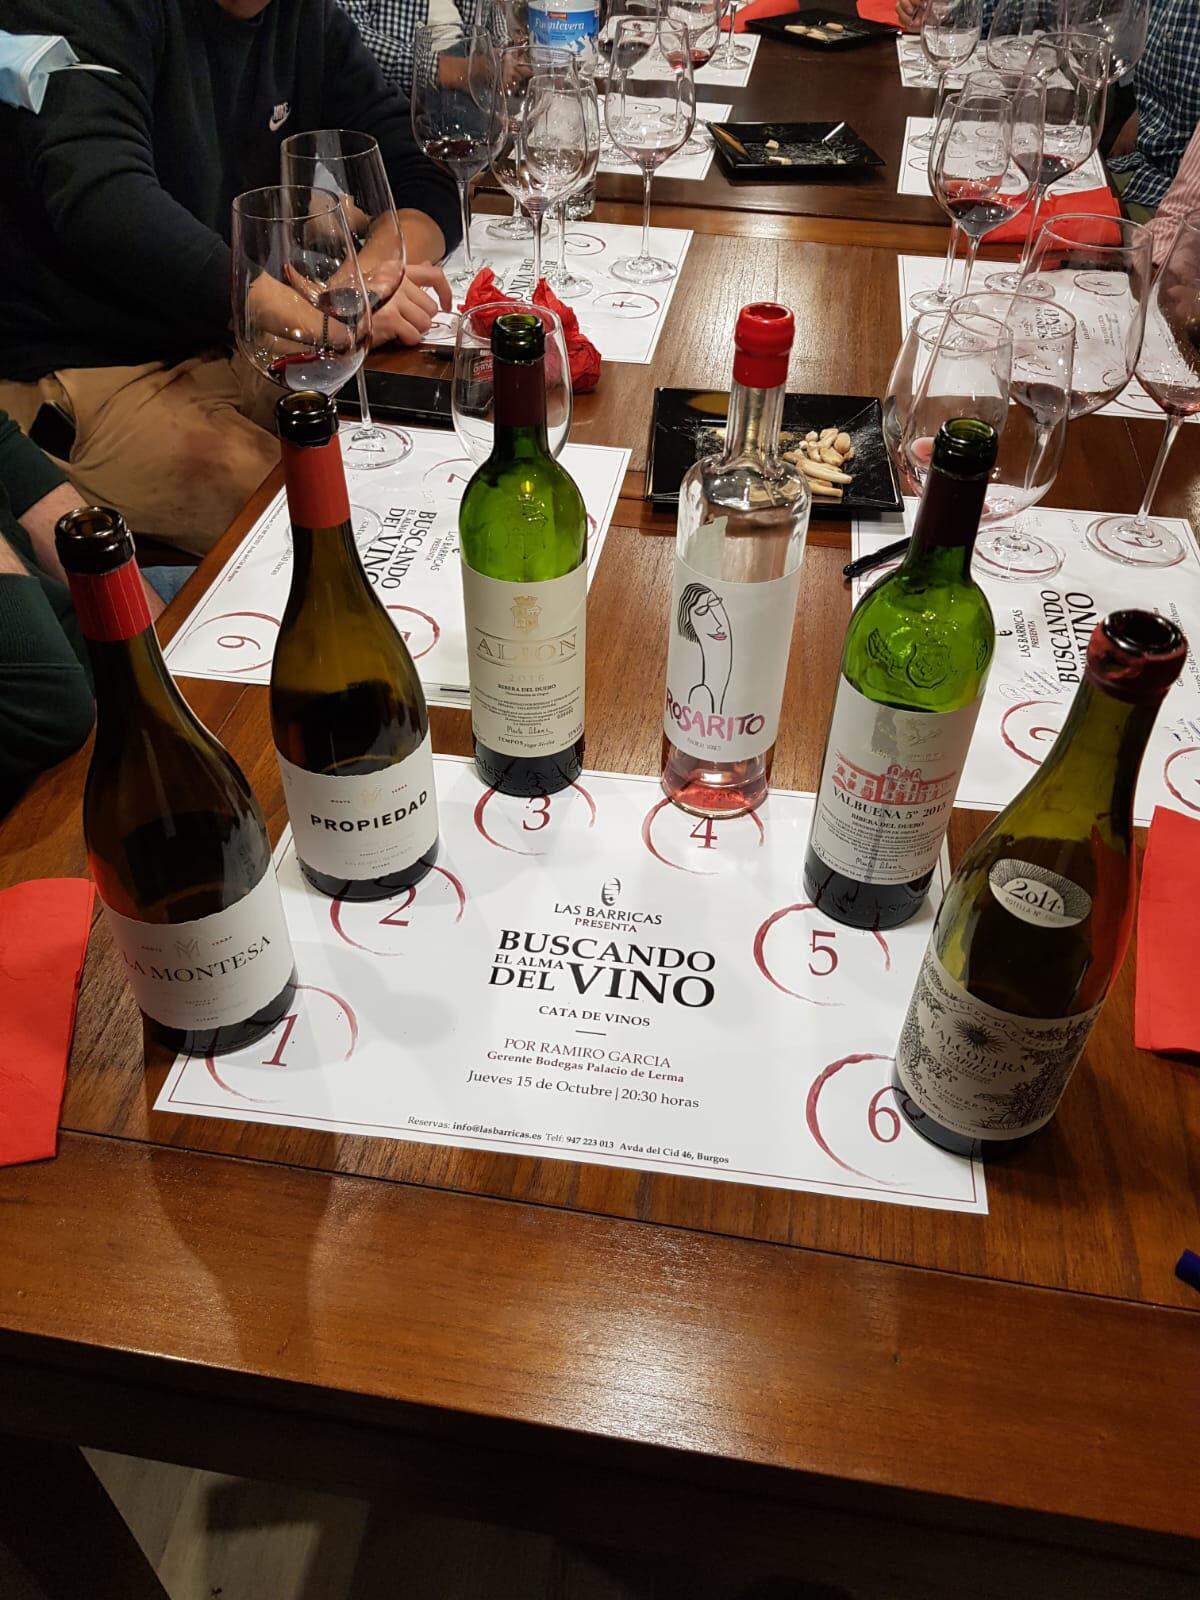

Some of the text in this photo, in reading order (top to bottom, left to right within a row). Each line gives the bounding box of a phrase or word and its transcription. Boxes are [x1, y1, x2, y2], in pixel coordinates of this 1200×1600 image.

[381, 510, 438, 589] BUSCANDO
[217, 635, 261, 650] 6
[1012, 609, 1031, 658] LAS BARRICAS
[1040, 590, 1080, 683] BUSCANDO
[666, 687, 765, 741] ROSARITO
[310, 790, 428, 832] PROPIEDAD
[522, 794, 551, 831] 3
[833, 786, 901, 820] VALBUENA
[690, 817, 718, 850] 4
[378, 885, 417, 927] 2
[554, 903, 663, 925] LAS BARRICAS
[574, 917, 638, 933] PRESENTA
[150, 935, 272, 982] MONTESA
[494, 953, 565, 970] EL ALMA
[498, 929, 716, 973] BUSCANDO
[808, 929, 838, 976] 5
[488, 961, 716, 1008] DEL VINO
[538, 1005, 651, 1027] CATA DE VINOS
[262, 1013, 299, 1067] 1
[503, 1038, 672, 1068] POR RAMIRO GARCIA
[487, 1050, 685, 1083] Gerente Bodegas Palacio de Lerma
[466, 1069, 700, 1108] Jueves 15 de Octubre 20:30 horas
[867, 1085, 901, 1143] 6
[407, 1115, 451, 1130] Reservas:
[452, 1121, 542, 1141] info@lasbarricas.es
[566, 1135, 582, 1145] 947
[583, 1137, 598, 1146] 223
[599, 1140, 615, 1149] 013
[619, 1142, 645, 1153] Avda
[646, 1145, 661, 1155] del
[662, 1147, 680, 1158] Cid
[681, 1149, 694, 1160] 46,
[696, 1151, 730, 1165] Burgos
